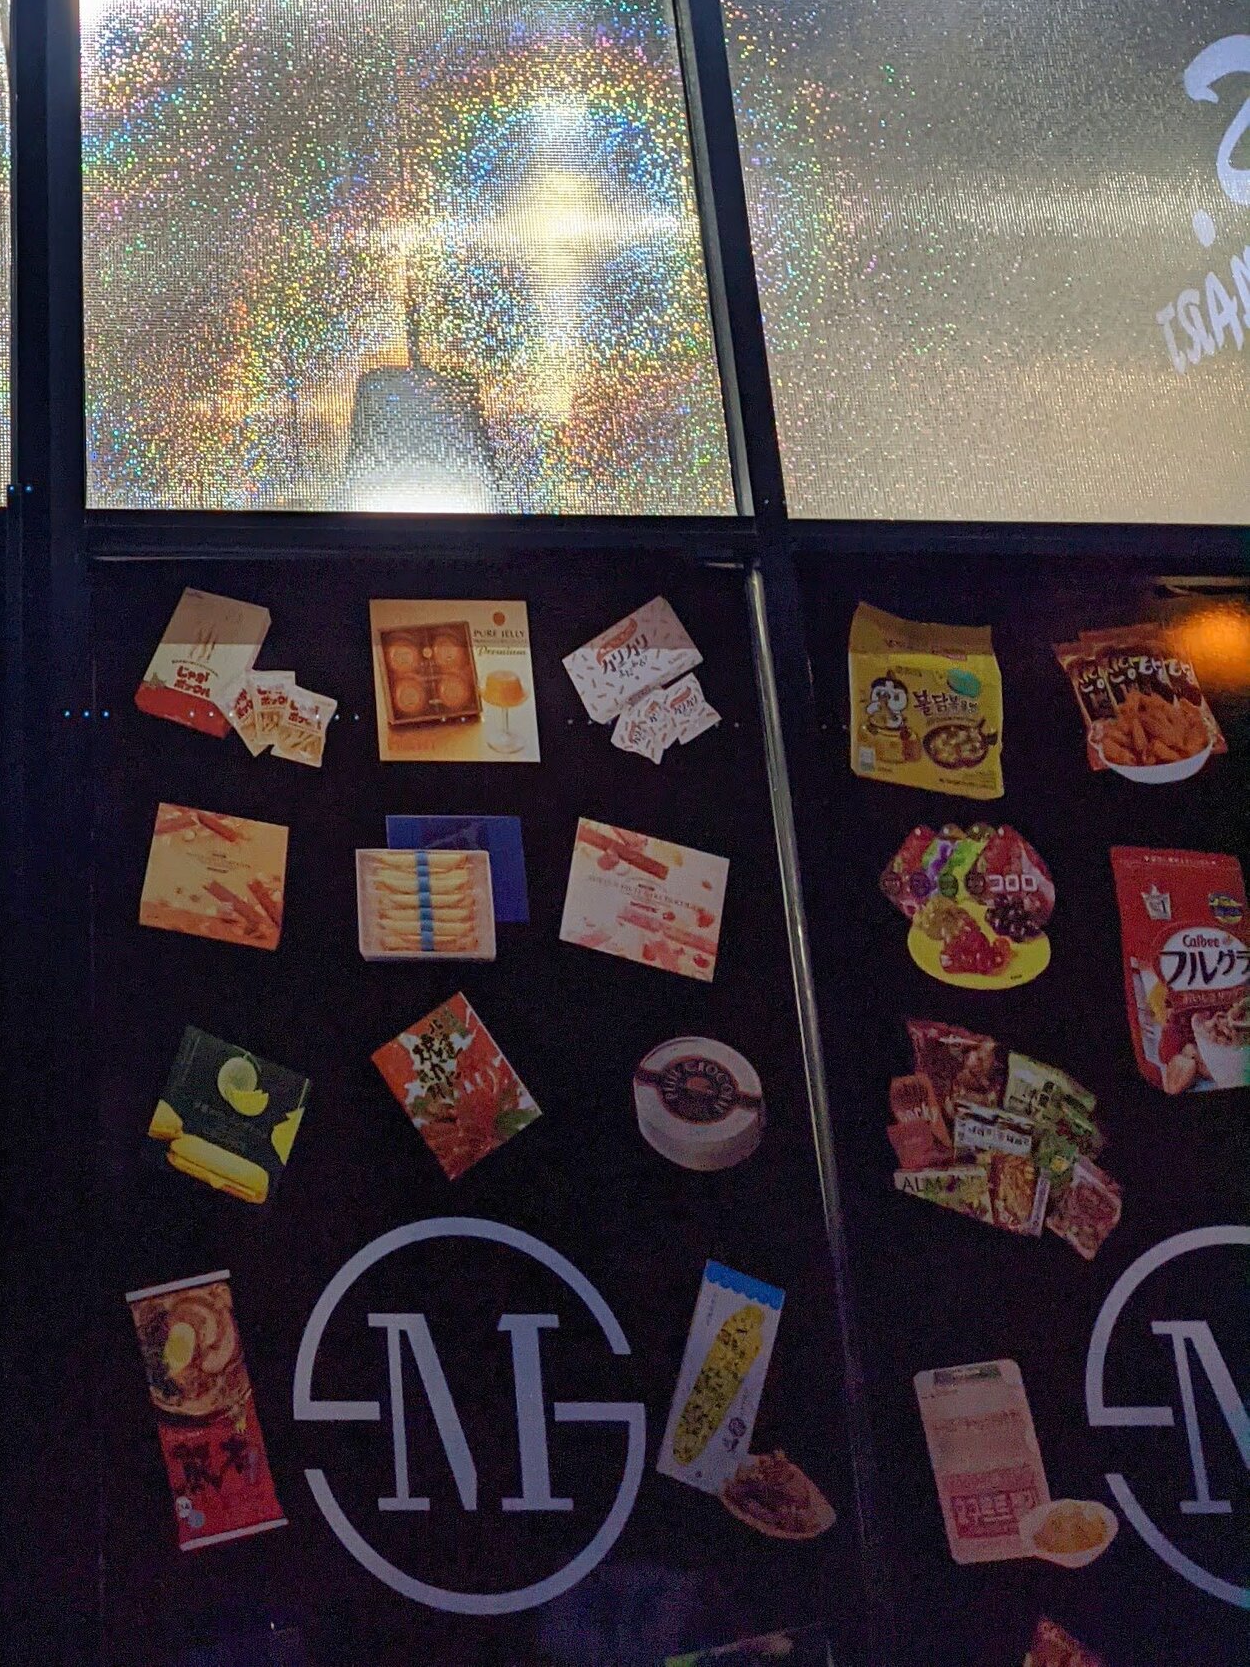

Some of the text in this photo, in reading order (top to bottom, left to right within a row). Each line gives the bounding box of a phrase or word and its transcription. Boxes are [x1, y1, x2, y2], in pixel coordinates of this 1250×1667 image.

[473, 629, 525, 639] PURE JELLY
[478, 645, 526, 657] Premium
[1182, 934, 1220, 948] Calbee
